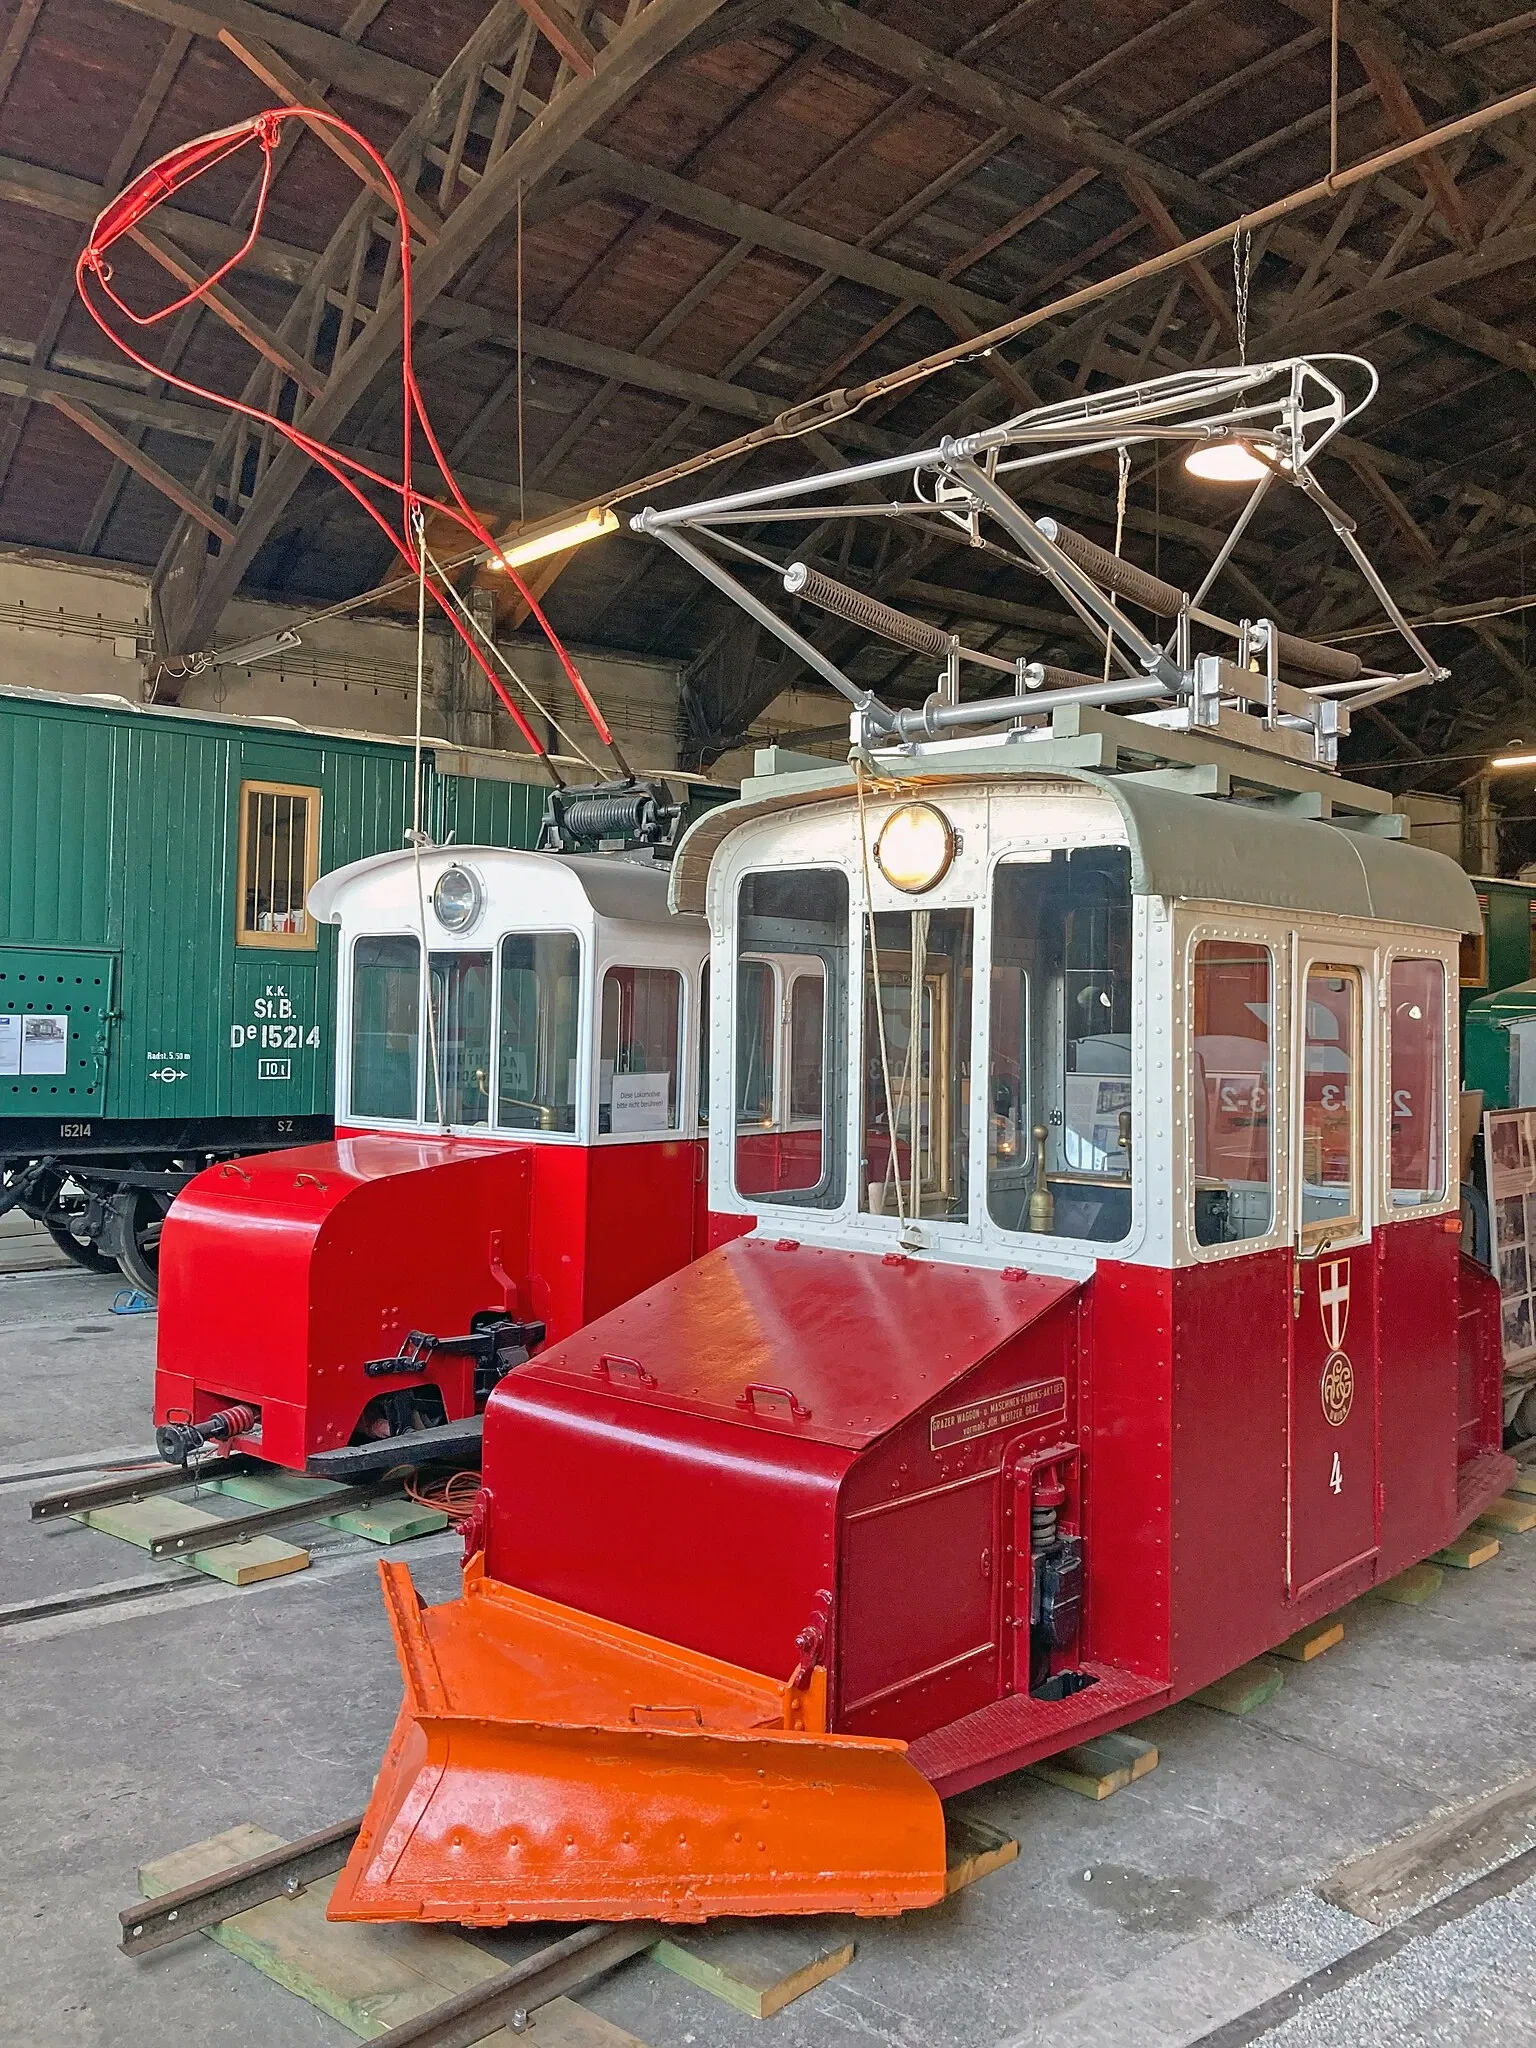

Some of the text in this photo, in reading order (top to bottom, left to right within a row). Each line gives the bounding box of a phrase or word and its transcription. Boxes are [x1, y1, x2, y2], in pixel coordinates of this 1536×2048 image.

[266, 985, 288, 997] K.K.
[253, 998, 297, 1018] St.B.
[261, 1025, 320, 1049] 15214
[266, 1062, 278, 1075] 10
[620, 1090, 660, 1099] Diese Lokomotive
[616, 1101, 628, 1109] bitte
[628, 1100, 640, 1108] nicht
[60, 1124, 91, 1137] 15214
[932, 1415, 955, 1432] GRAZER
[963, 1421, 986, 1435] vormals
[1025, 1403, 1039, 1416] GRAZ
[1329, 1451, 1343, 1495] 4
